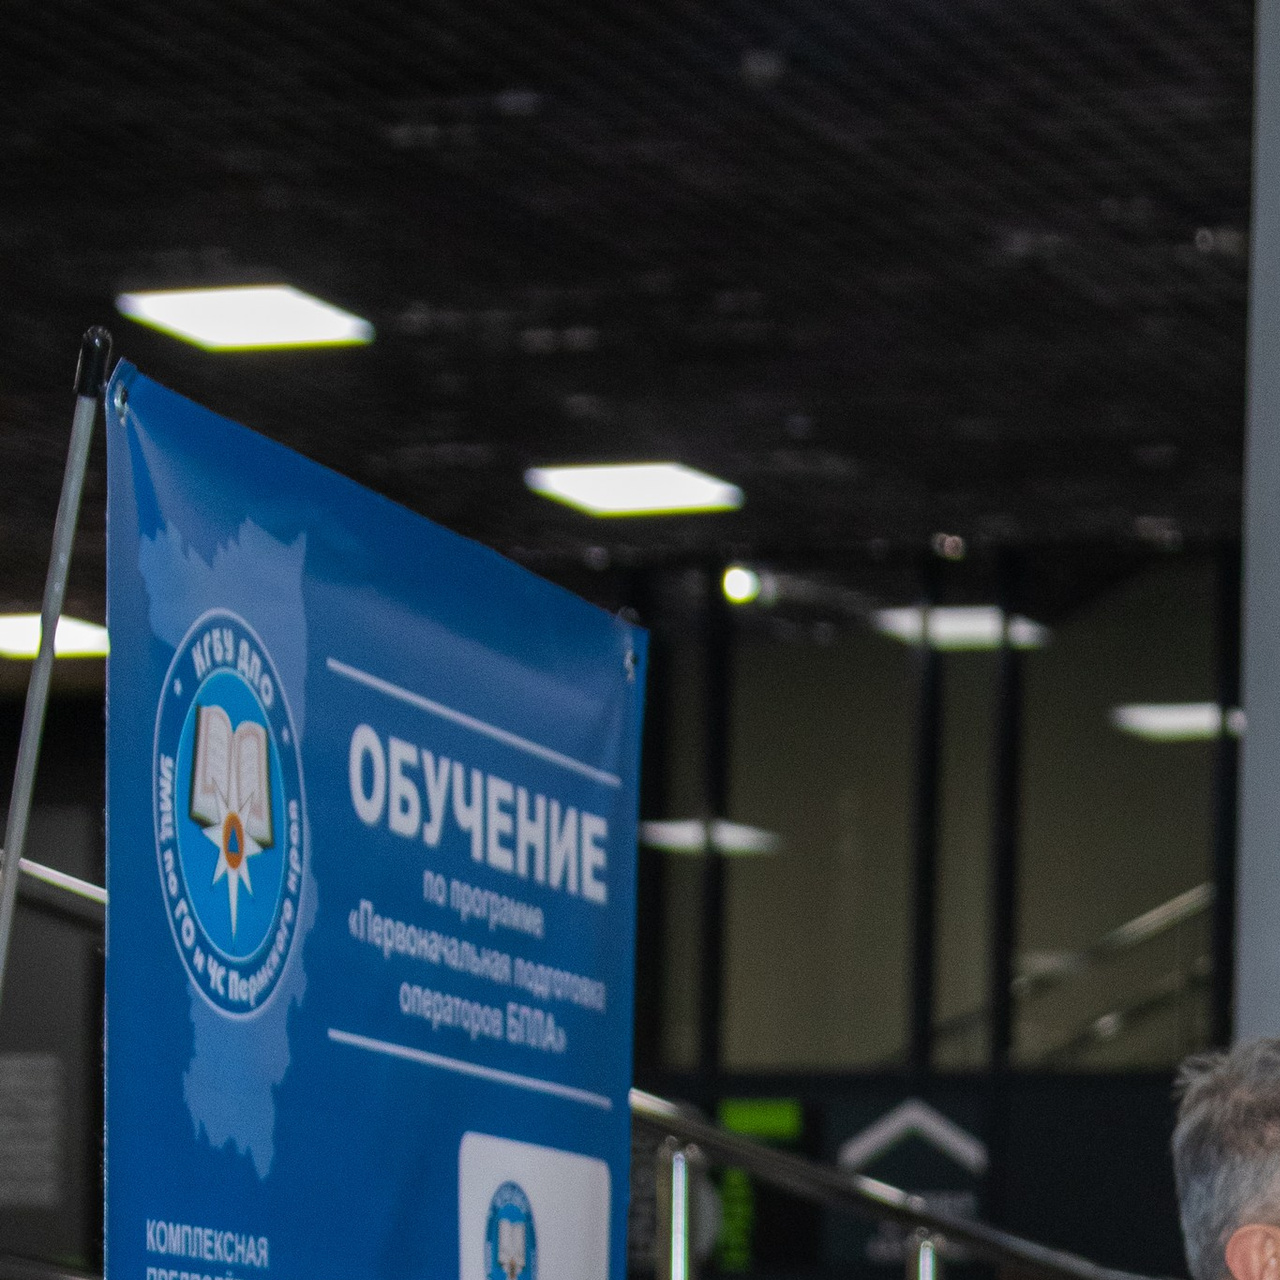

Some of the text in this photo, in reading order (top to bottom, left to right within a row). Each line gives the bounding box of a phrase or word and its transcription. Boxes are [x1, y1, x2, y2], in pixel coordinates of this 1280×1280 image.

[237, 638, 275, 708] ДПО
[348, 723, 610, 906] ОБУЧЕНИЕ
[163, 848, 178, 897] по
[174, 897, 196, 948] ГО
[193, 946, 205, 973] и
[206, 954, 227, 995] ЧС
[228, 897, 293, 1007] Пермского
[287, 799, 301, 893] края
[423, 869, 545, 939] по программе
[399, 981, 568, 1053] операторов БПЛА»
[146, 1218, 269, 1268] КОМПЛЕКСНАЯ
